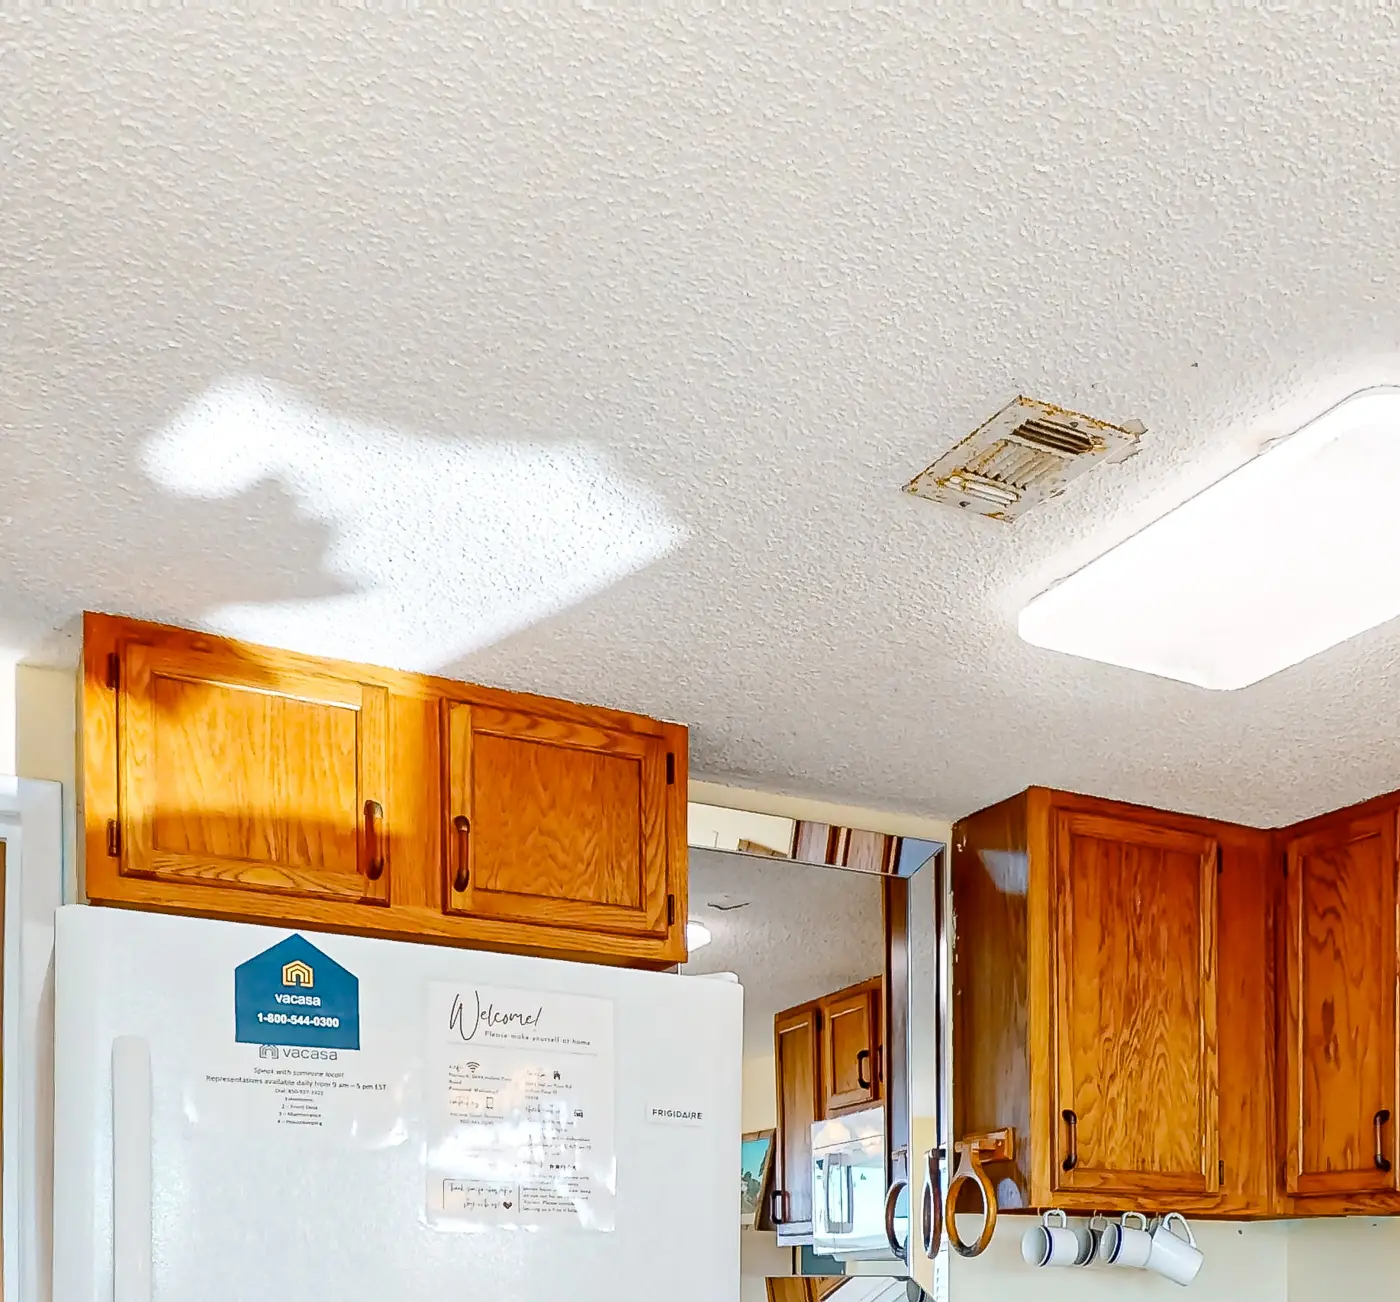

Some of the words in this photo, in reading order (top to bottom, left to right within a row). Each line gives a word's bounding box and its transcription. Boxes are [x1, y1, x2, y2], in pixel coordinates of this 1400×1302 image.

[274, 993, 322, 1007] vacasa
[257, 1012, 340, 1028] 1-800-544-0300
[449, 990, 543, 1041] Welcome!
[511, 1033, 529, 1041] make
[282, 1048, 338, 1061] vacasa
[652, 1108, 703, 1120] FRIGIDAIRE
